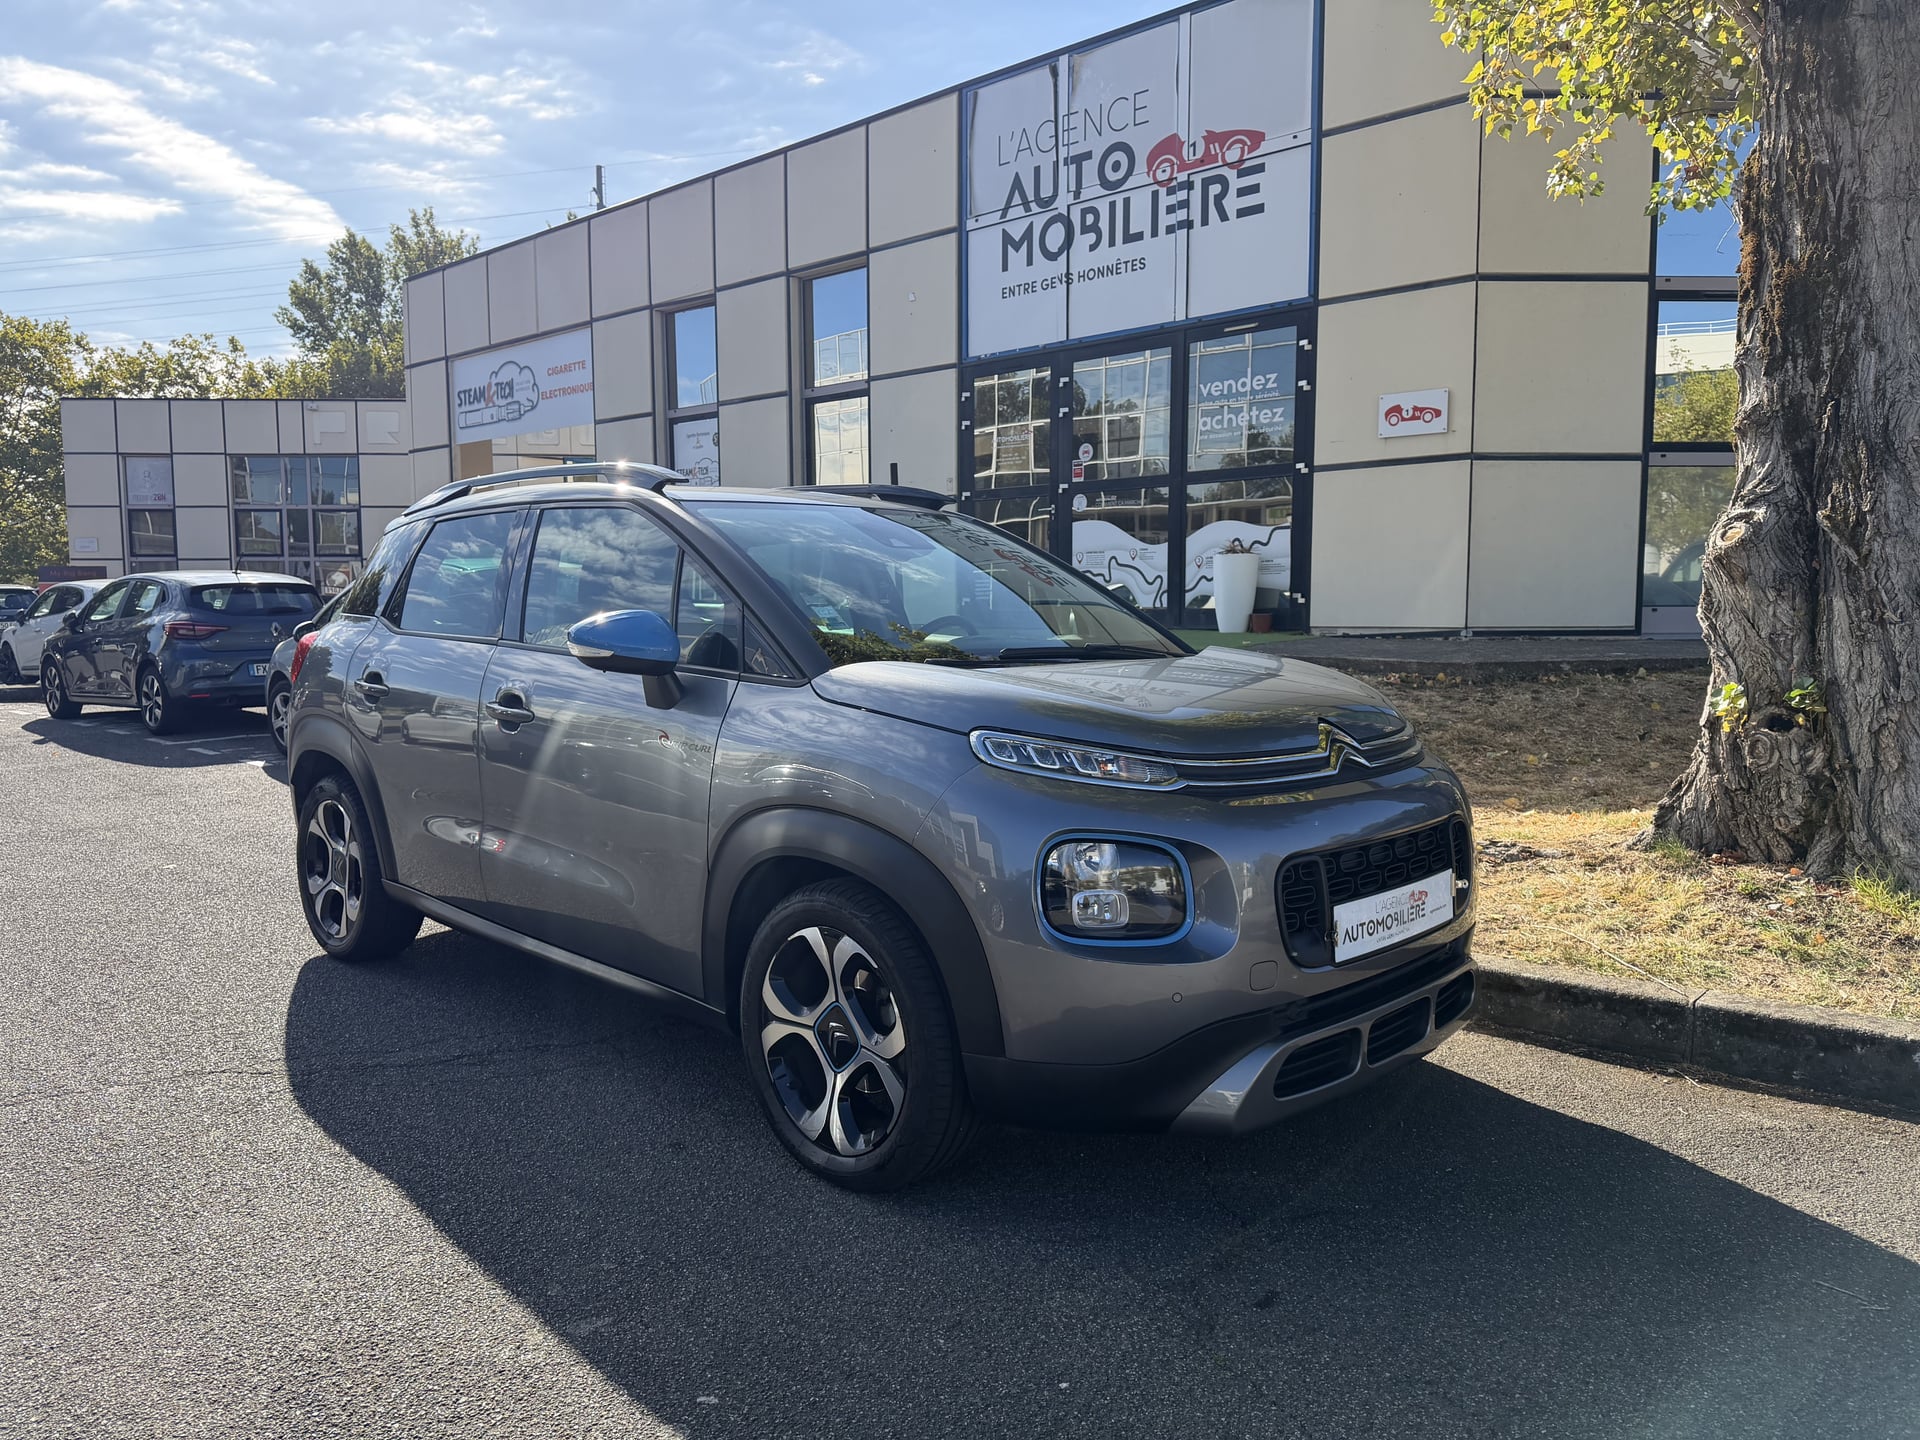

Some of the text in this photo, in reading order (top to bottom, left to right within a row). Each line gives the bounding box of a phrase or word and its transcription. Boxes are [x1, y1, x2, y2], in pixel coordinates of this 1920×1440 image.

[998, 88, 1150, 167] L'AGENCE
[999, 140, 1136, 220] AUTO
[1001, 256, 1147, 300] ENTRE GENS HONNÊTES
[547, 360, 587, 377] CIGARETTE
[1200, 367, 1278, 398] vendez
[541, 381, 594, 401] ELECTRONIQUE
[1200, 405, 1285, 431] achetez
